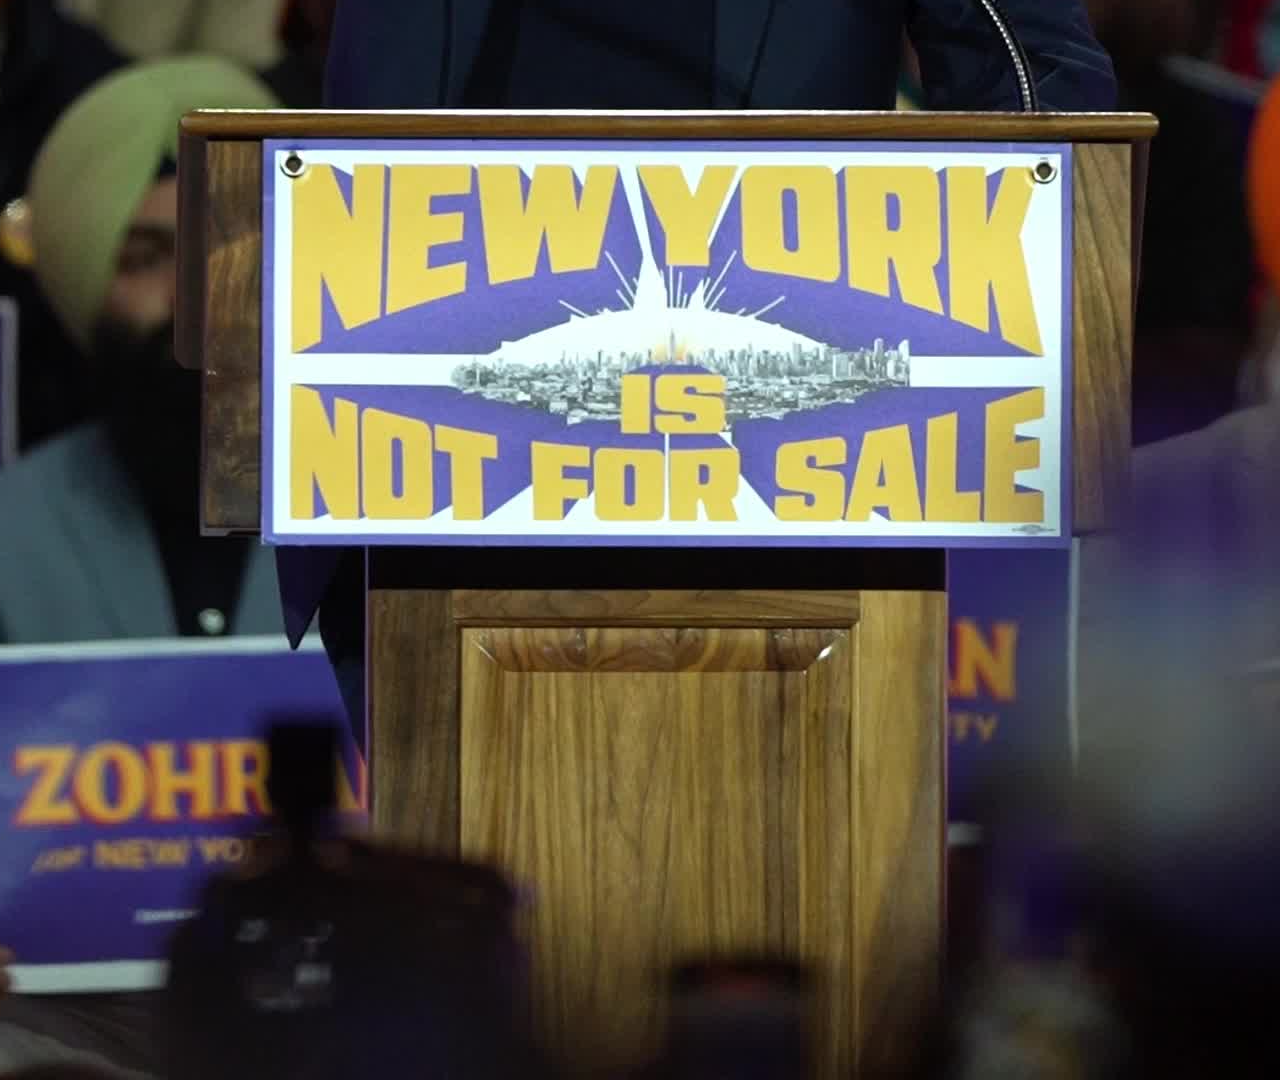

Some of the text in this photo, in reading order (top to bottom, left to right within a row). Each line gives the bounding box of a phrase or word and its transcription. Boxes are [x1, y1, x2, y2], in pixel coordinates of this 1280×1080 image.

[292, 165, 1044, 356] NEW YORK
[290, 383, 1045, 523] NOT FOR SALE
[621, 373, 726, 435] IS
[93, 837, 192, 871] NEW
